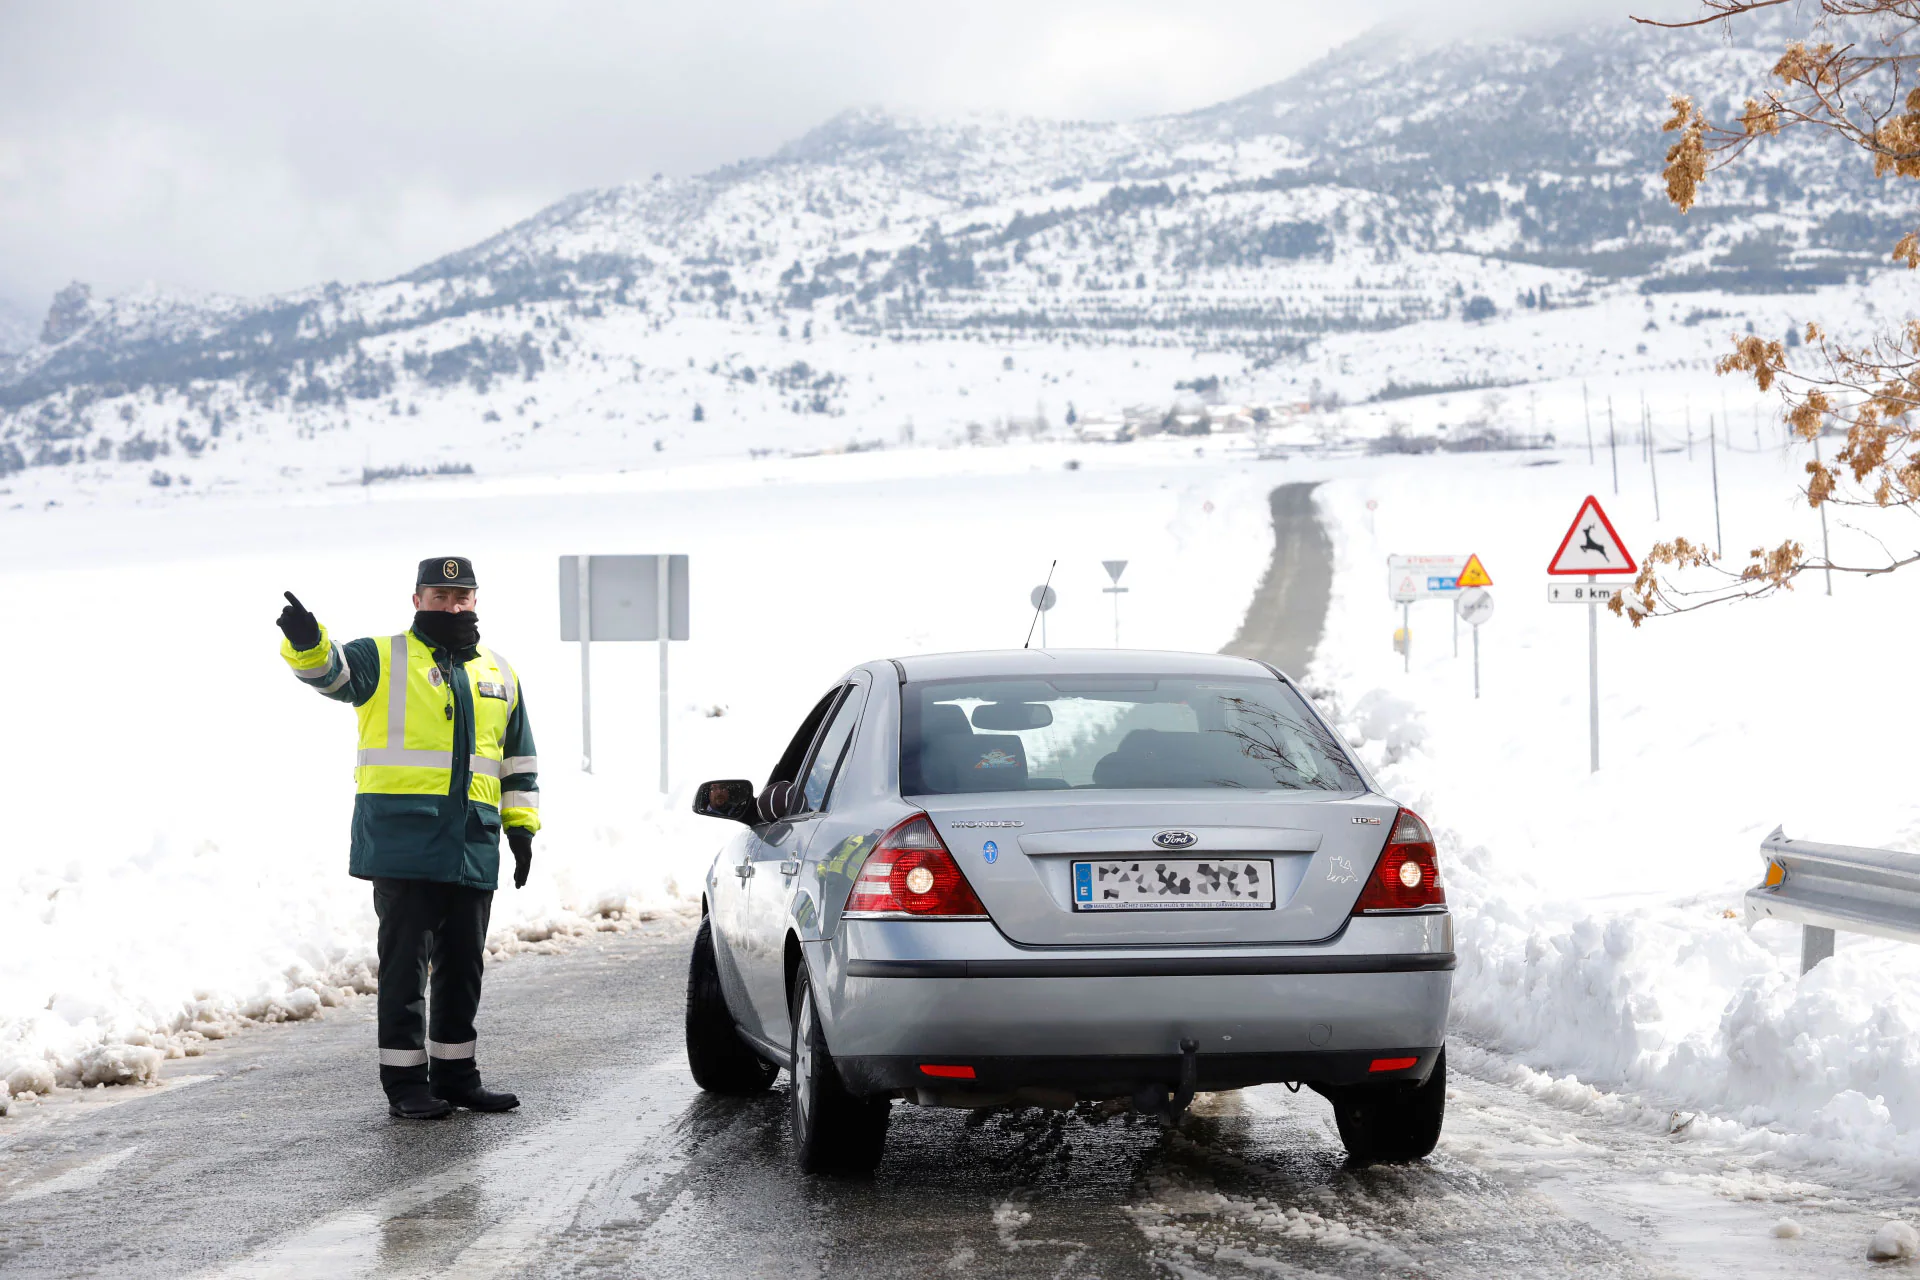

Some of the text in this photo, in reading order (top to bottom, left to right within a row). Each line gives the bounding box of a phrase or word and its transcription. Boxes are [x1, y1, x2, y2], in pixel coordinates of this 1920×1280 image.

[1575, 588, 1610, 598] 8 km
[951, 820, 1025, 828] MONDEO
[1163, 832, 1188, 844] Ford
[1081, 886, 1088, 896] E
